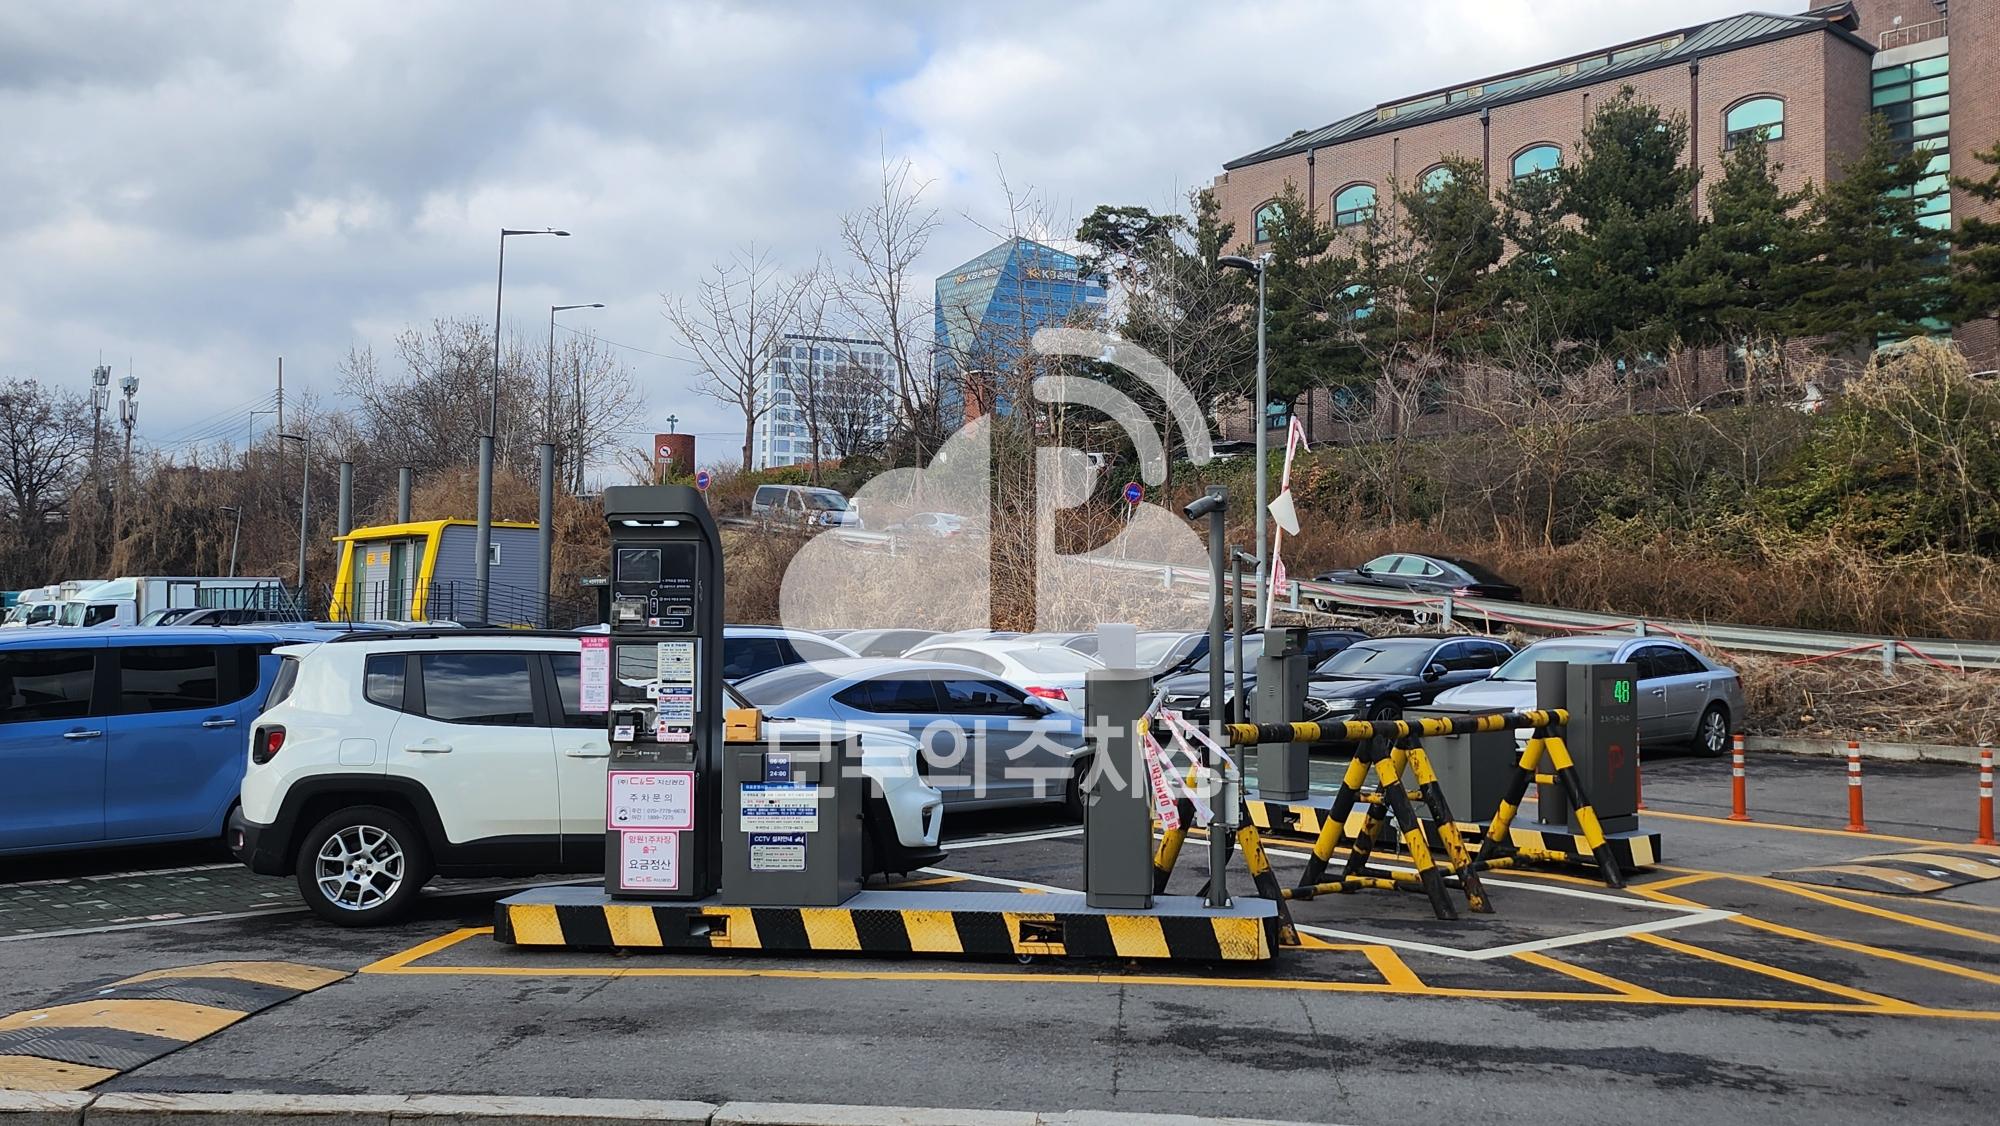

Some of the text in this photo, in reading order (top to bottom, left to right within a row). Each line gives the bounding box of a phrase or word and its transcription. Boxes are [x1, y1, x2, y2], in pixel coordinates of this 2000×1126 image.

[1615, 681, 1629, 702] 48
[642, 846, 657, 854] 출구
[628, 859, 671, 870] 요금정산
